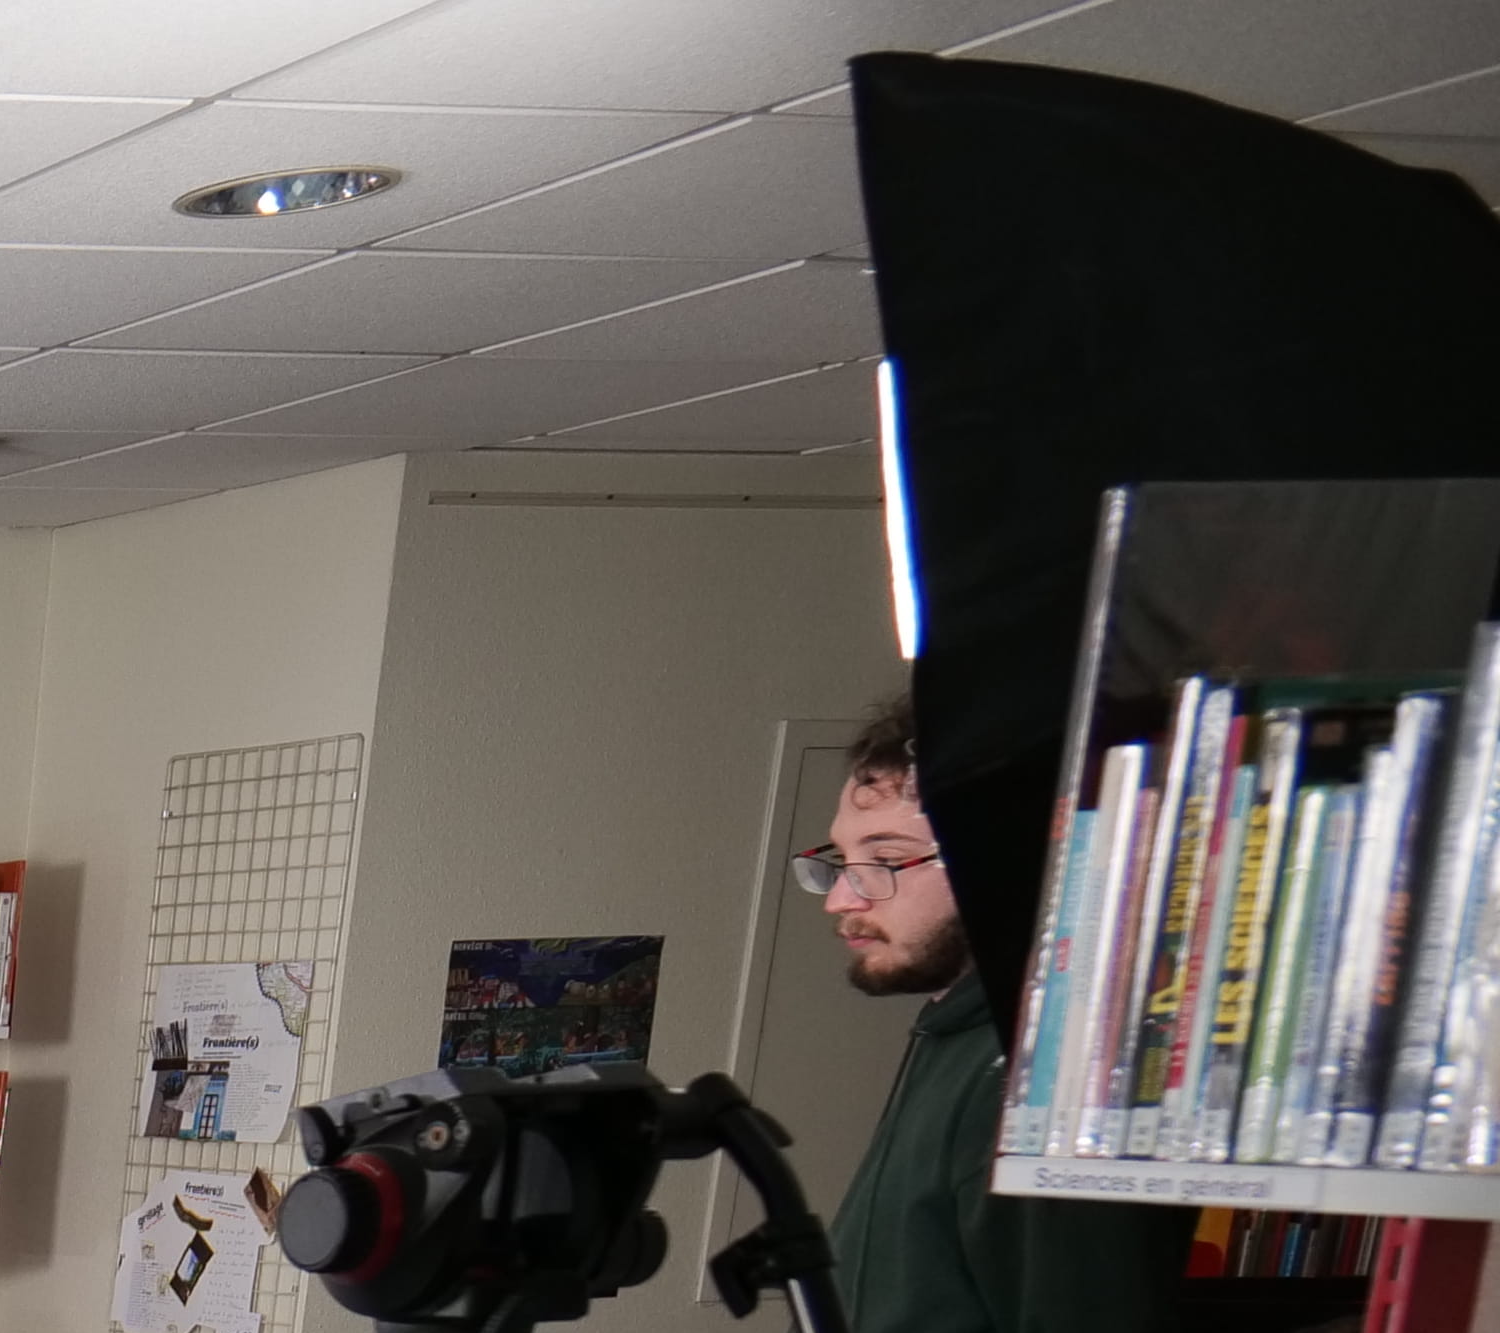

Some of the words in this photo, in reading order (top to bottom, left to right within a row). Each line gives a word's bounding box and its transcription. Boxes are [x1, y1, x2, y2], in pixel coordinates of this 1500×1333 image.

[1224, 803, 1272, 971] SCIENCES
[1211, 979, 1253, 1045] LES
[1034, 1167, 1138, 1193] Sciences
[1145, 1177, 1174, 1194] en
[1180, 1176, 1273, 1201] général
